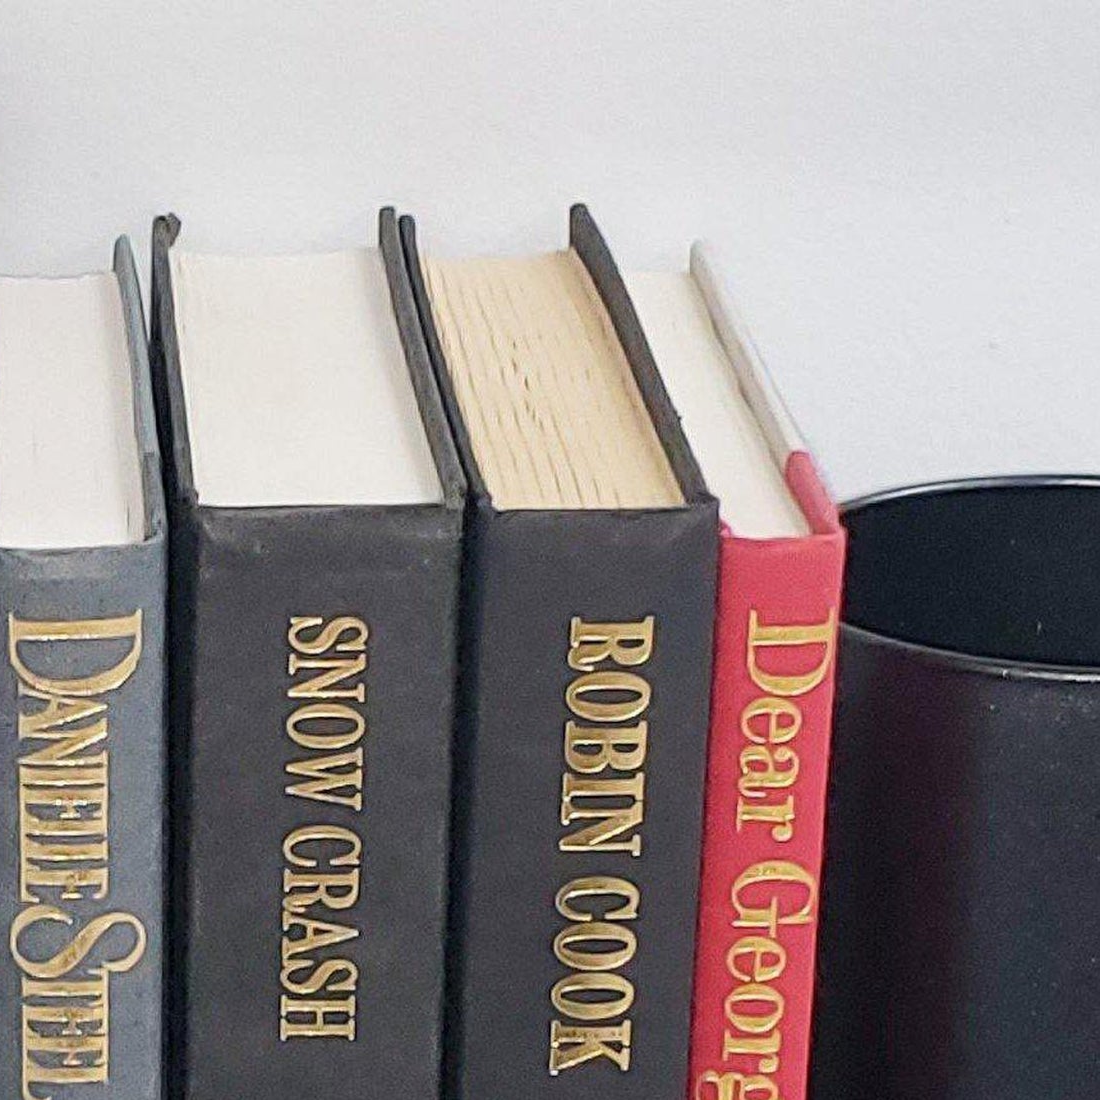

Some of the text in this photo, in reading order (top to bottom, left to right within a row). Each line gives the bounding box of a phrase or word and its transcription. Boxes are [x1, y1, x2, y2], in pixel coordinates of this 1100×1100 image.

[9, 609, 142, 902] DANIELLE
[280, 617, 368, 1041] SNOW CRASH
[549, 616, 654, 1075] ROBIN COOK
[736, 608, 836, 842] Dear
